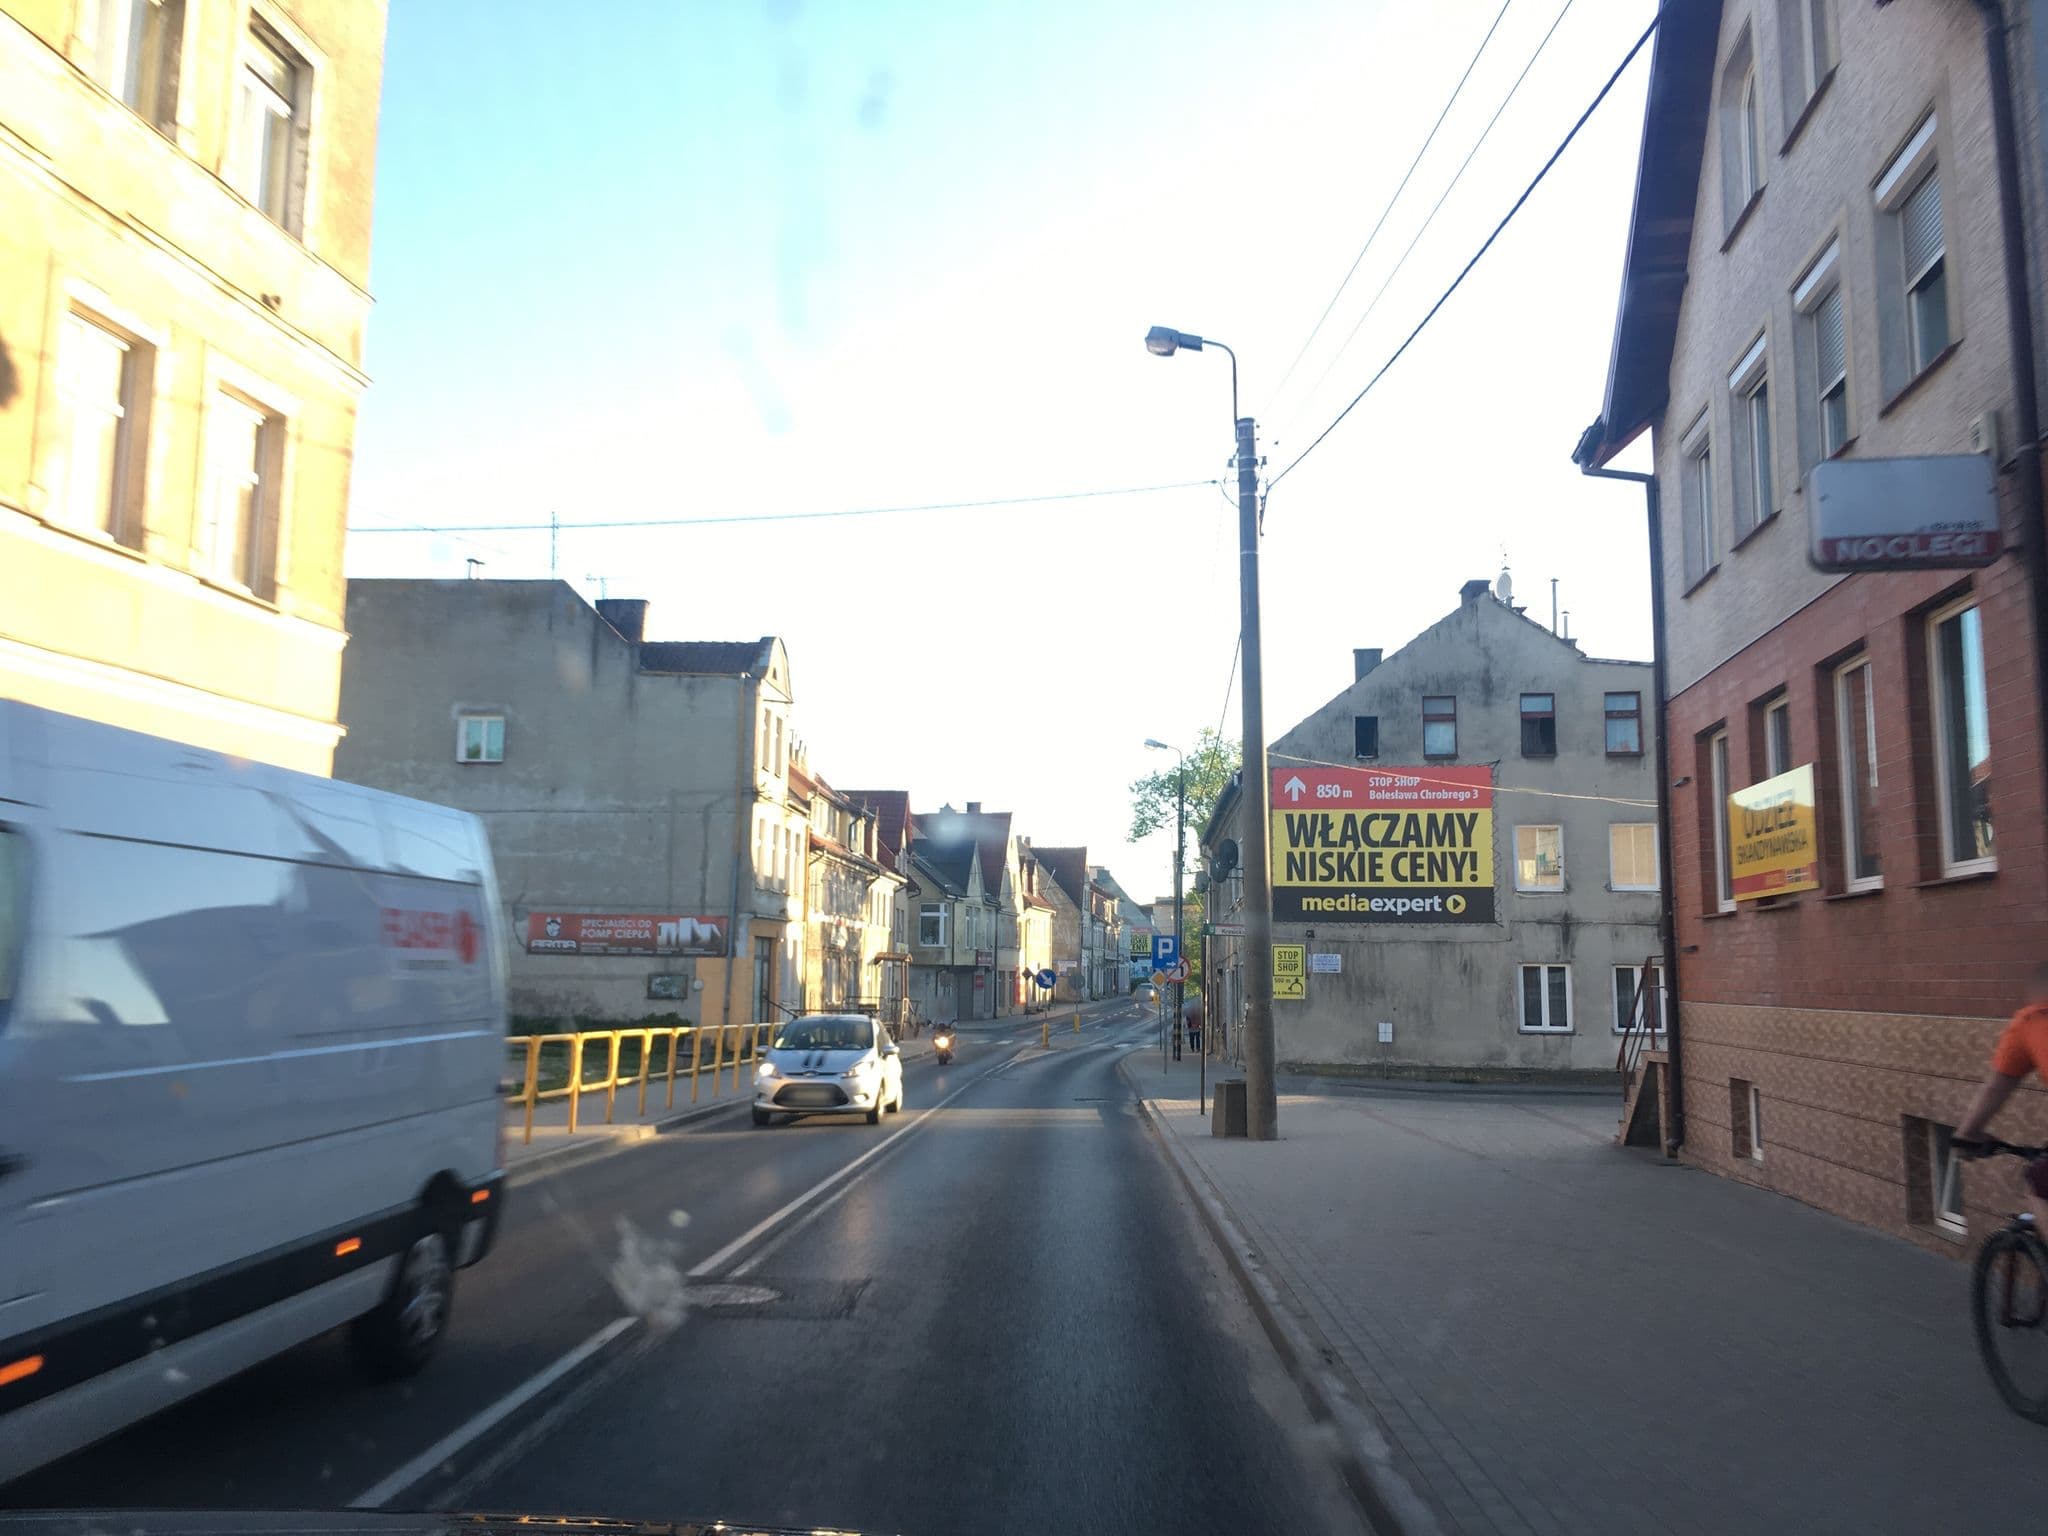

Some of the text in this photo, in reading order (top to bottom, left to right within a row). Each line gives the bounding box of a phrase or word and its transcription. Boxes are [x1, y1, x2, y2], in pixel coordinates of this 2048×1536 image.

[1836, 533, 1986, 561] NOCLEGI
[1369, 776, 1420, 787] STOP SHOP
[1316, 784, 1352, 798] 850 m
[1369, 789, 1479, 801] Bolesława Chrobrego 3
[1285, 813, 1479, 851] WŁĄCZAMY
[1286, 852, 1479, 882] NISKIE CENY!
[1302, 893, 1442, 915] mediaexpert
[1158, 938, 1174, 959] P
[1277, 951, 1299, 959] STOP
[1277, 963, 1299, 971] SHOP
